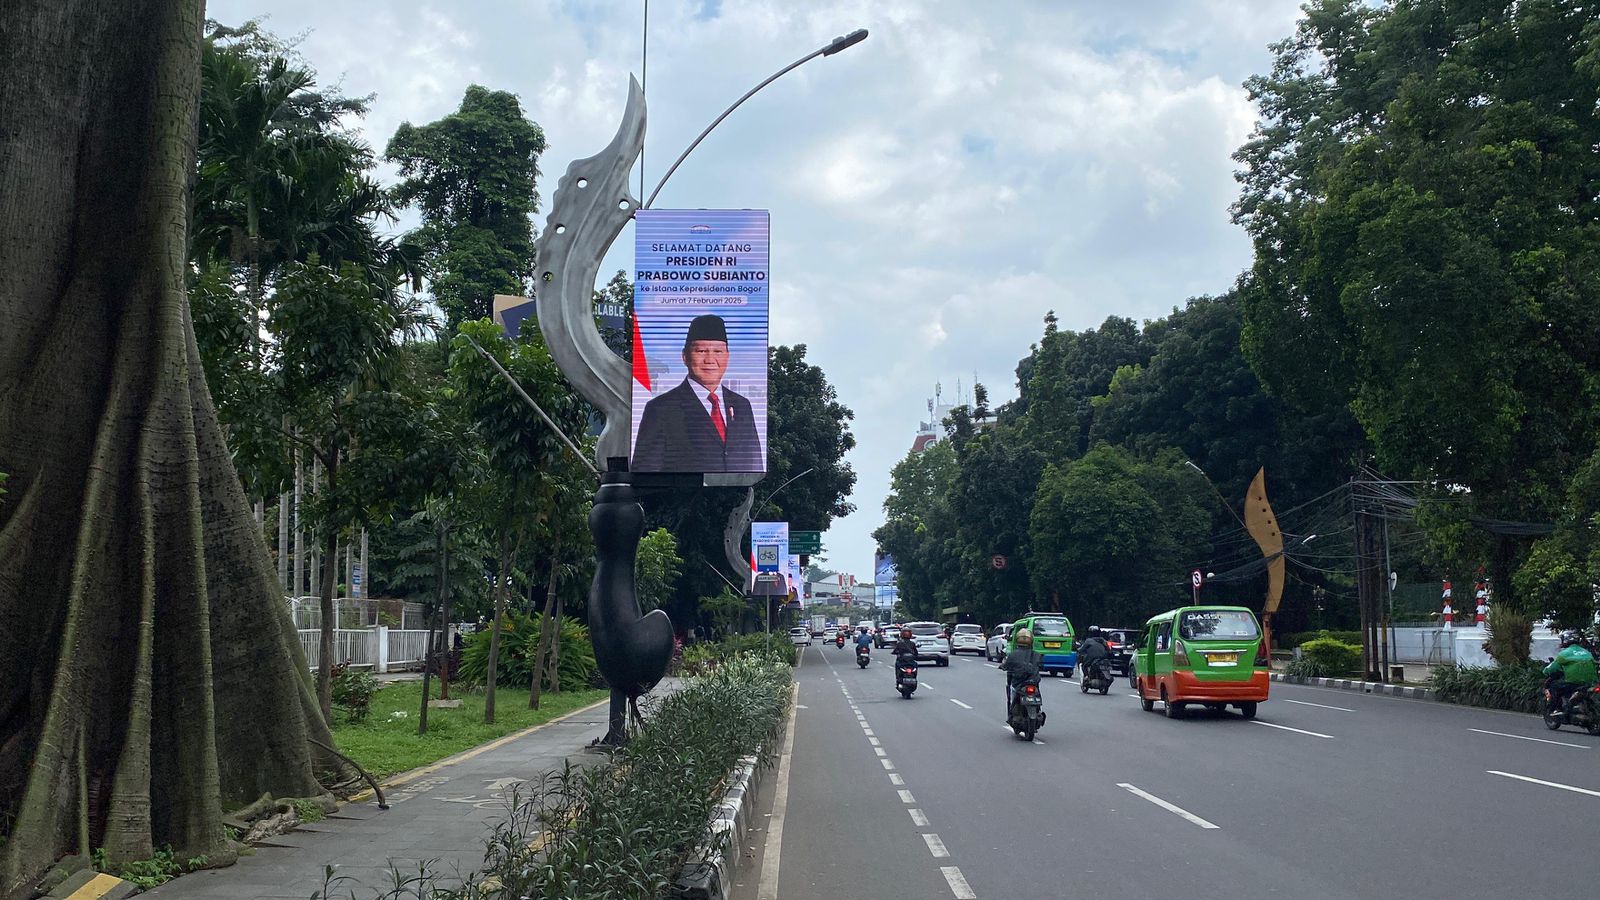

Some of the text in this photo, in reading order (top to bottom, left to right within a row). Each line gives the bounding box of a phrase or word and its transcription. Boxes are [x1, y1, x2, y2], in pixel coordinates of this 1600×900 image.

[651, 243, 752, 253] SELAMAT DATANG
[665, 256, 737, 266] PRESIDEN RI
[637, 270, 766, 281] PRABOWO SUBIANTO
[640, 284, 650, 292] ke
[679, 284, 736, 294] Kepresidenan
[738, 285, 762, 294] Bogor
[688, 296, 692, 304] 7
[693, 296, 723, 304] Februari
[724, 296, 742, 304] 2025
[593, 303, 625, 318] ILABLE
